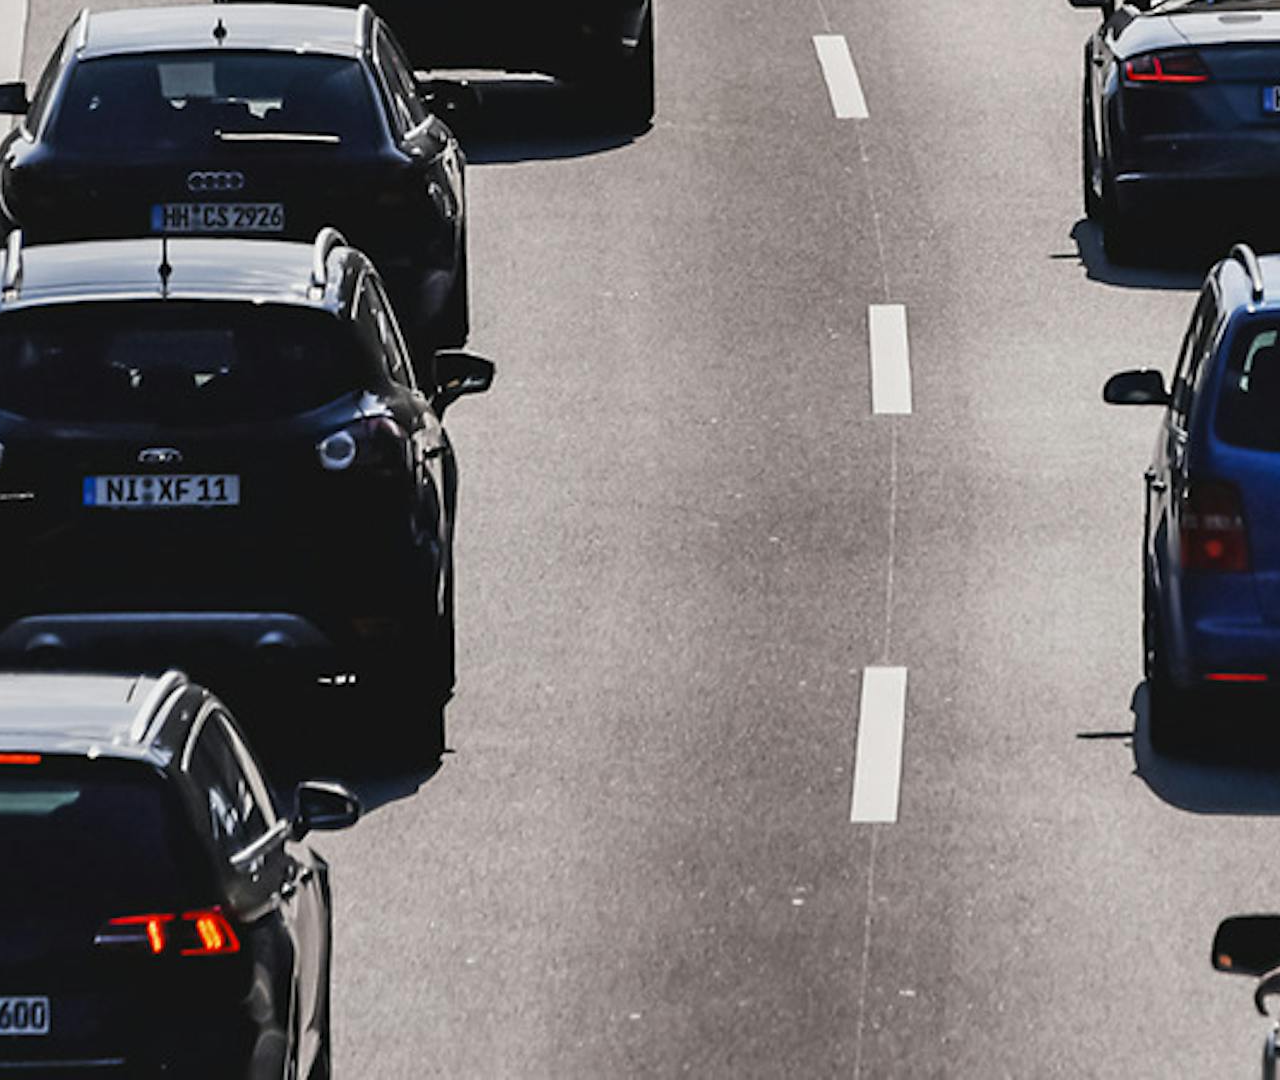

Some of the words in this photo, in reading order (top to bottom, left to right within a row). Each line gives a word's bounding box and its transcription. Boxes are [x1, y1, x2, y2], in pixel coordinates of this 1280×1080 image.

[164, 206, 189, 227] HH
[204, 206, 228, 226] CS
[233, 206, 281, 226] 2926
[107, 479, 138, 502] NI
[160, 479, 191, 502] XF
[198, 478, 228, 501] 11
